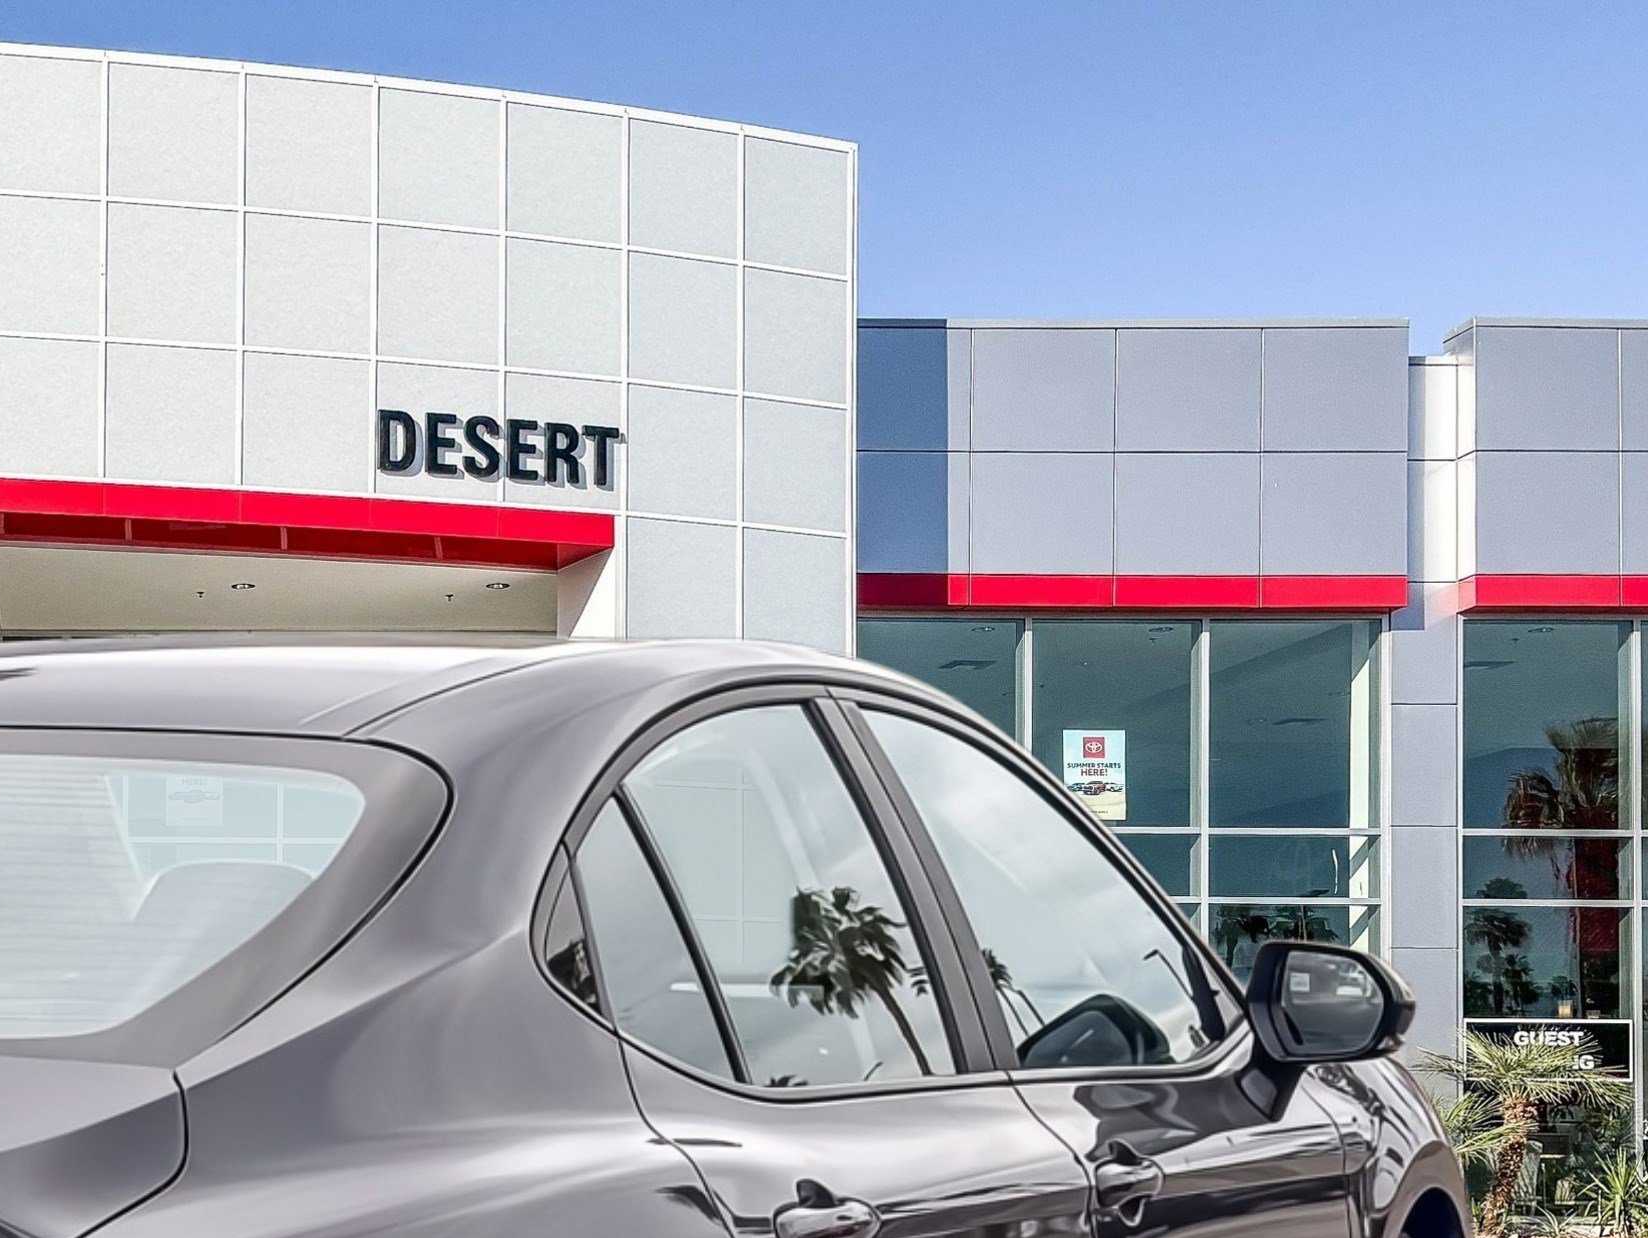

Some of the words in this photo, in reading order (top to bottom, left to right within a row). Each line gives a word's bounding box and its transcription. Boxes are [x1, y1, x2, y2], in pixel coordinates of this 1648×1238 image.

[377, 409, 620, 487] DESERT
[1080, 768, 1108, 776] HERE!
[1513, 1030, 1584, 1047] GUEST
